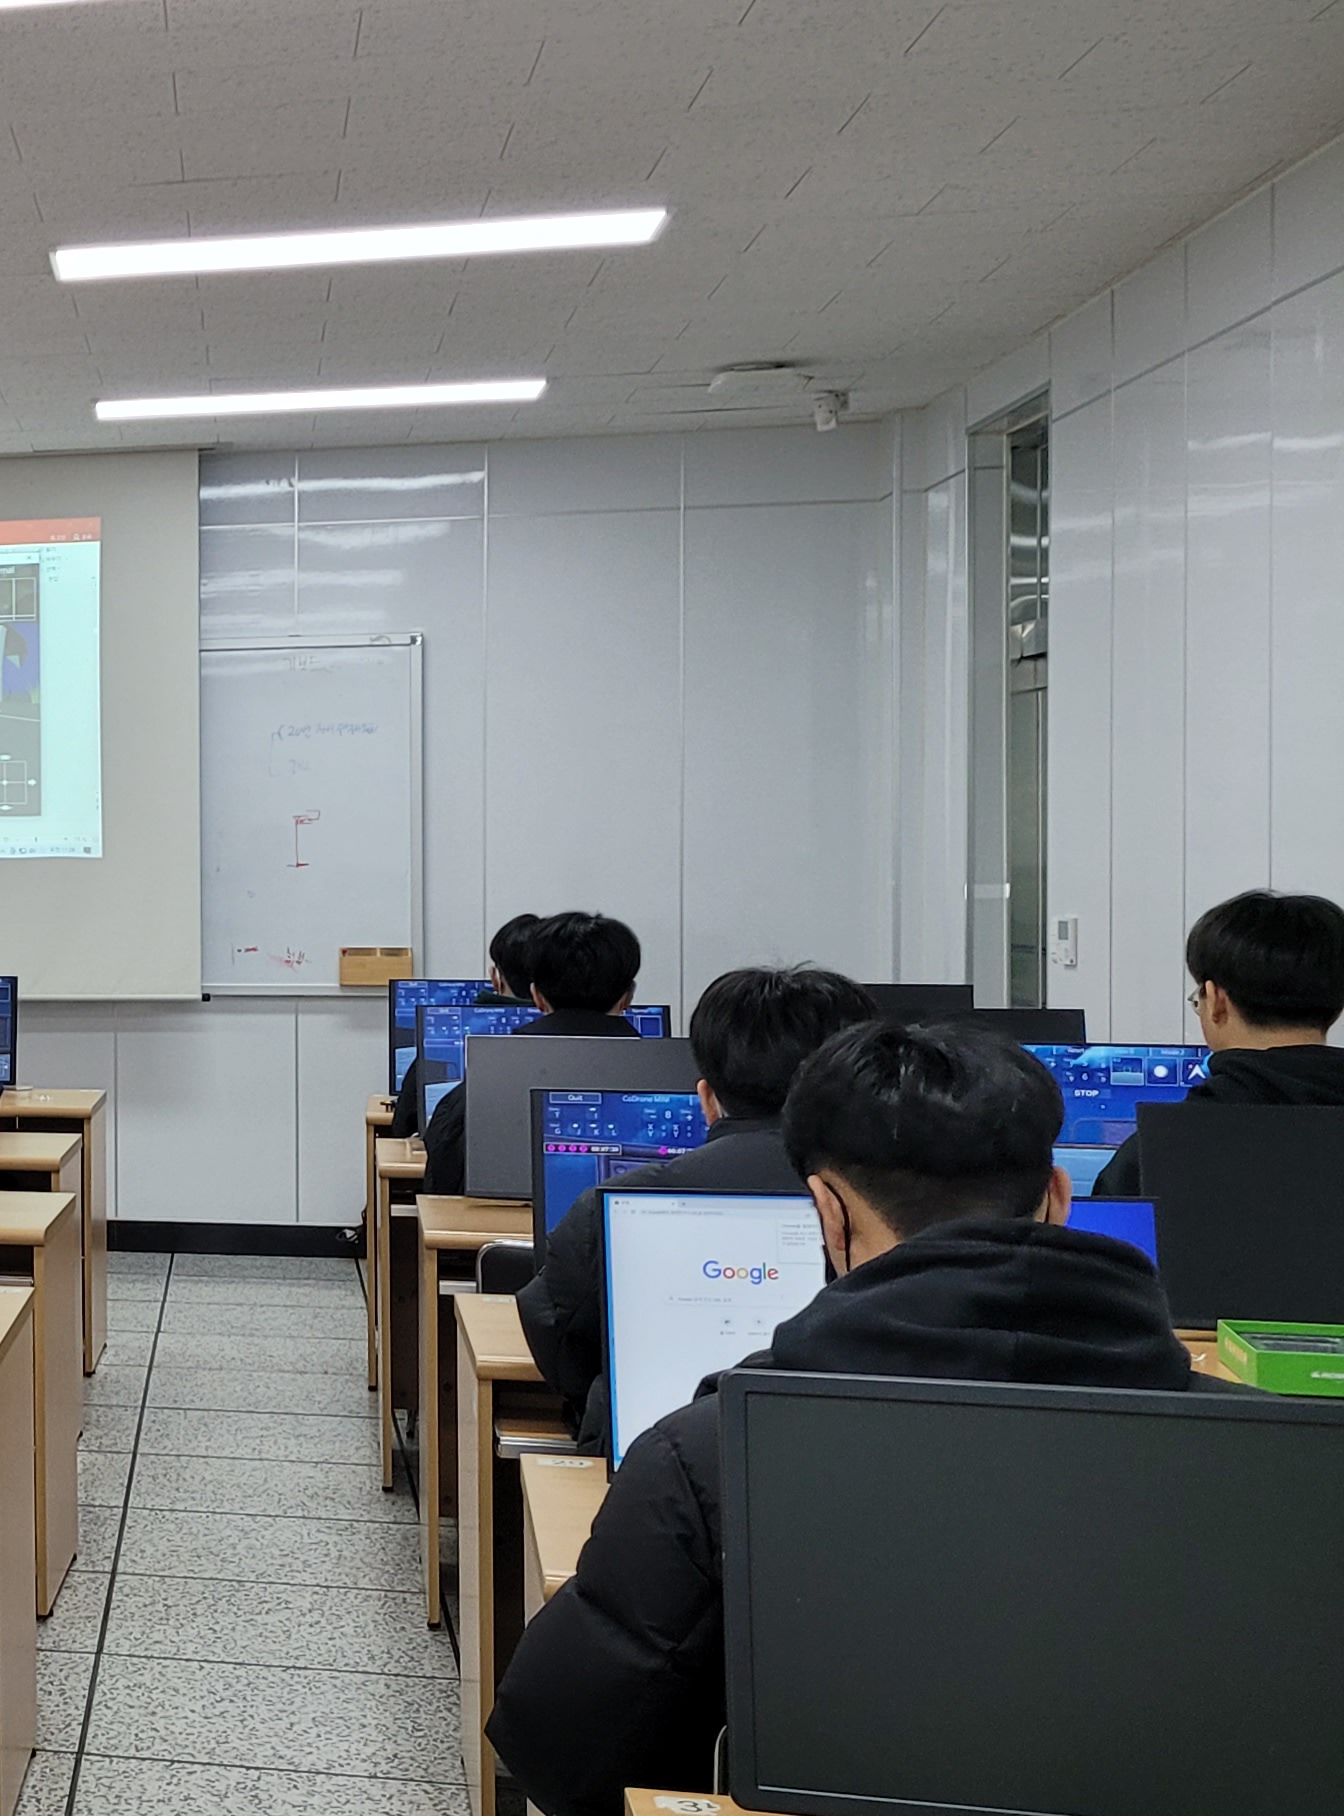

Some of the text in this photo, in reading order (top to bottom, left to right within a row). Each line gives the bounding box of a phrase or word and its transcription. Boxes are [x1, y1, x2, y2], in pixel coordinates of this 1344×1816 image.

[1081, 1072, 1089, 1081] 6
[1074, 1089, 1100, 1097] STOP
[567, 1094, 583, 1102] Quit
[622, 1095, 653, 1103] CoDrone
[664, 1110, 672, 1119] 8
[702, 1260, 779, 1285] Google
